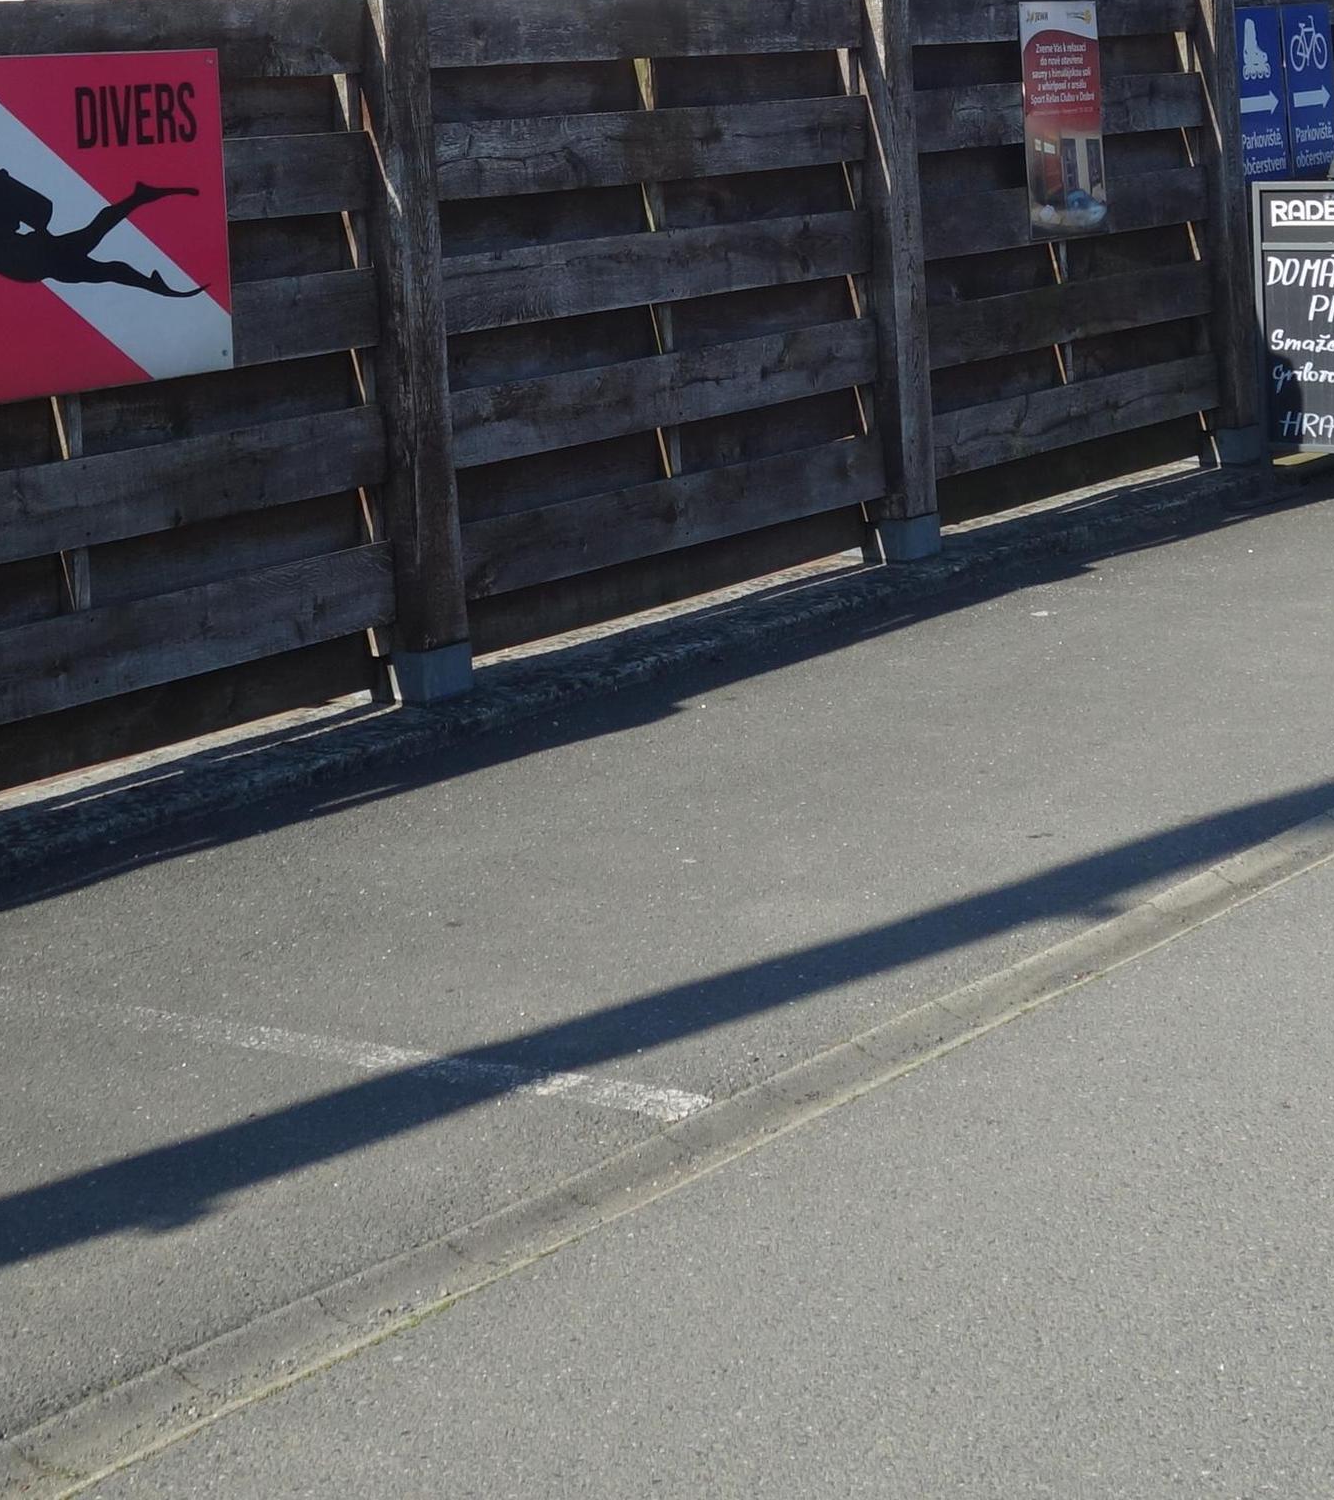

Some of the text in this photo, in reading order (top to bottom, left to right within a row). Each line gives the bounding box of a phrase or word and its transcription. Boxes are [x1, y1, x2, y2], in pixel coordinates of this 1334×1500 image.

[75, 82, 198, 149] DIVERS
[1242, 128, 1284, 149] Parkoviště,
[1295, 121, 1334, 143] Parkoviště,
